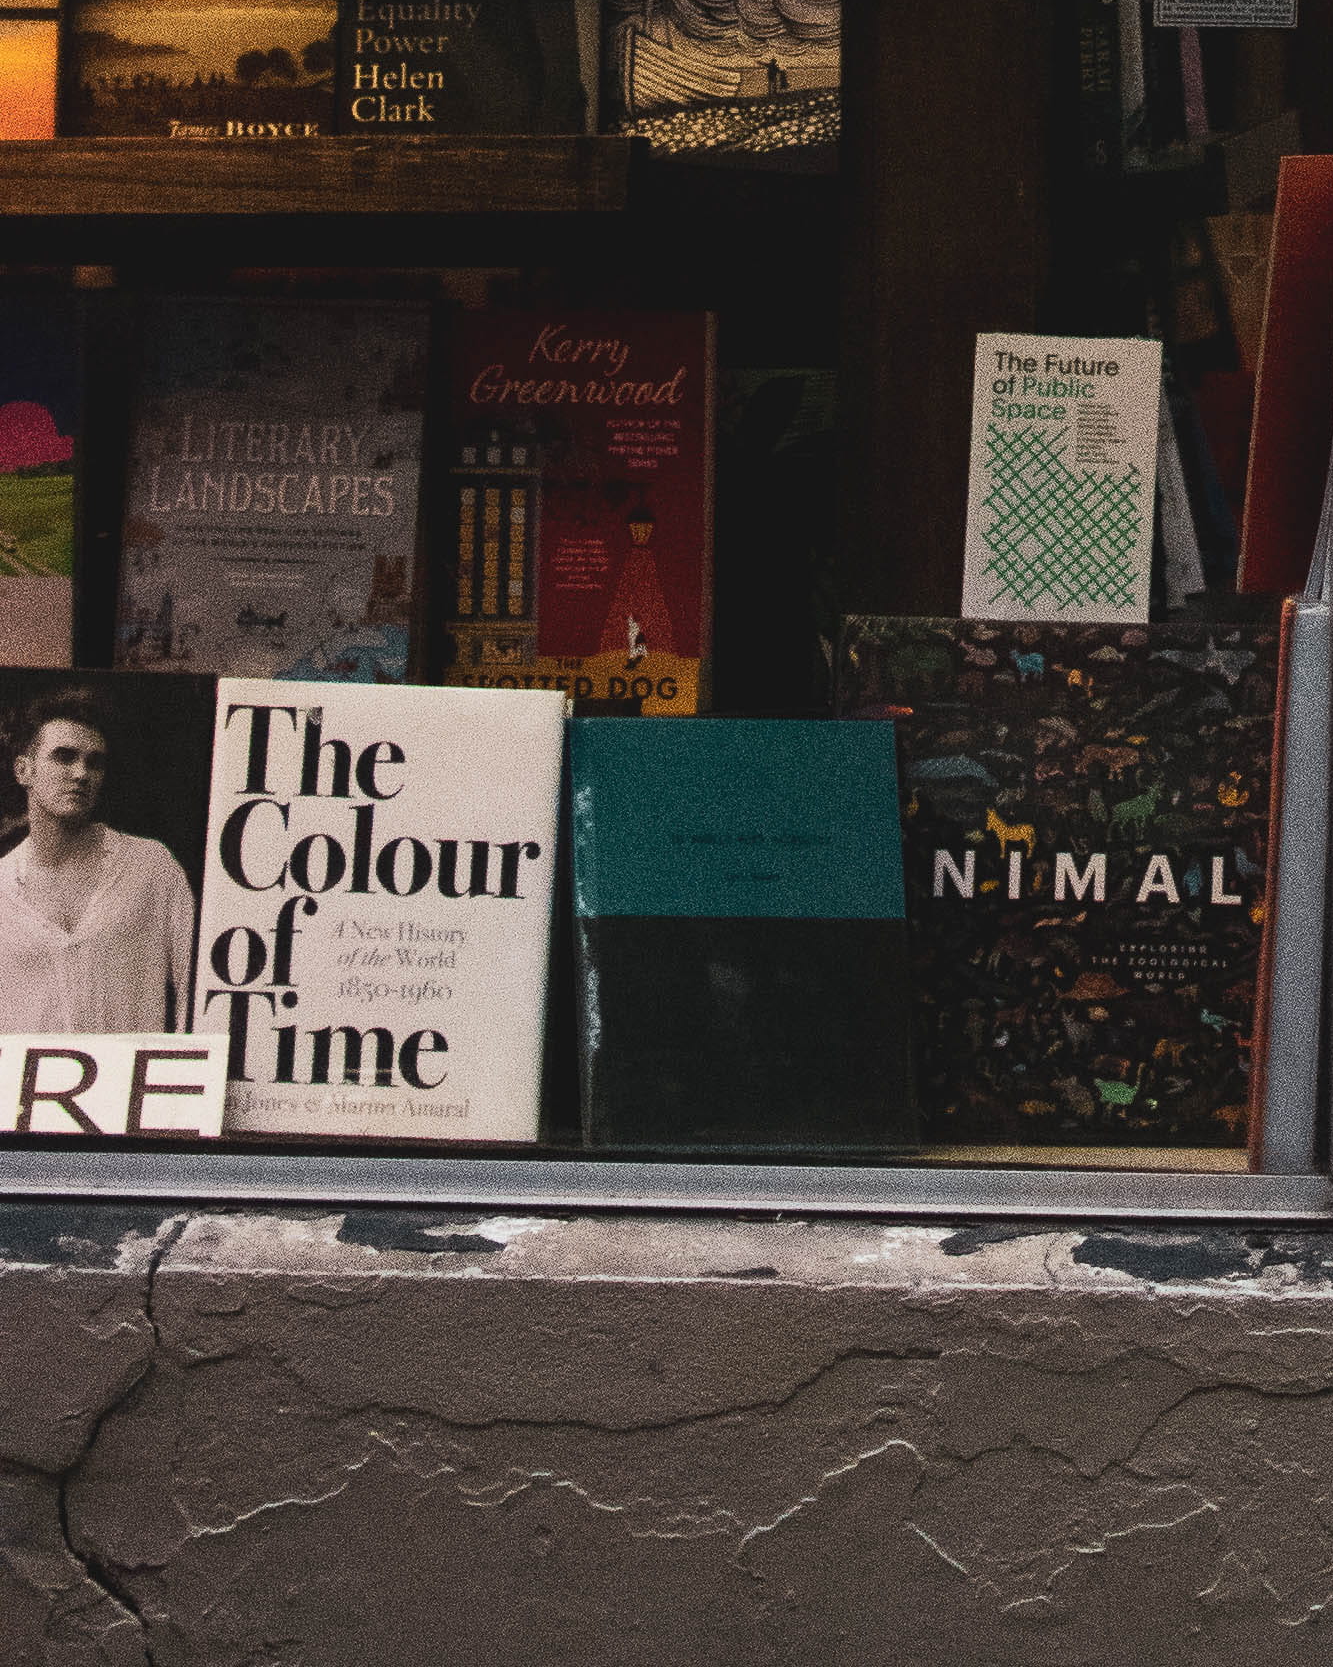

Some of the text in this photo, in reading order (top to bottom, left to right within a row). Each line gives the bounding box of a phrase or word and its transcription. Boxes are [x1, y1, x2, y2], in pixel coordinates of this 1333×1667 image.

[354, 27, 450, 55] Power
[352, 61, 445, 90] Helen
[350, 93, 436, 123] Clark
[528, 323, 631, 378] Kerry
[995, 351, 1120, 376] The Future
[469, 362, 688, 407] Greenwood
[992, 375, 1096, 399] of Public
[990, 397, 1067, 422] Space
[181, 413, 370, 465] LITERARY
[149, 465, 394, 517] LANDSCAPES
[608, 676, 679, 701] DOG
[225, 703, 406, 800] The
[219, 799, 541, 900] Colour
[210, 893, 318, 988] of
[351, 921, 391, 942] New
[397, 923, 467, 945] History
[336, 947, 457, 970] of the World
[204, 990, 449, 1091] Time
[0, 1047, 210, 1140] RE
[400, 1097, 471, 1119] Amaral
